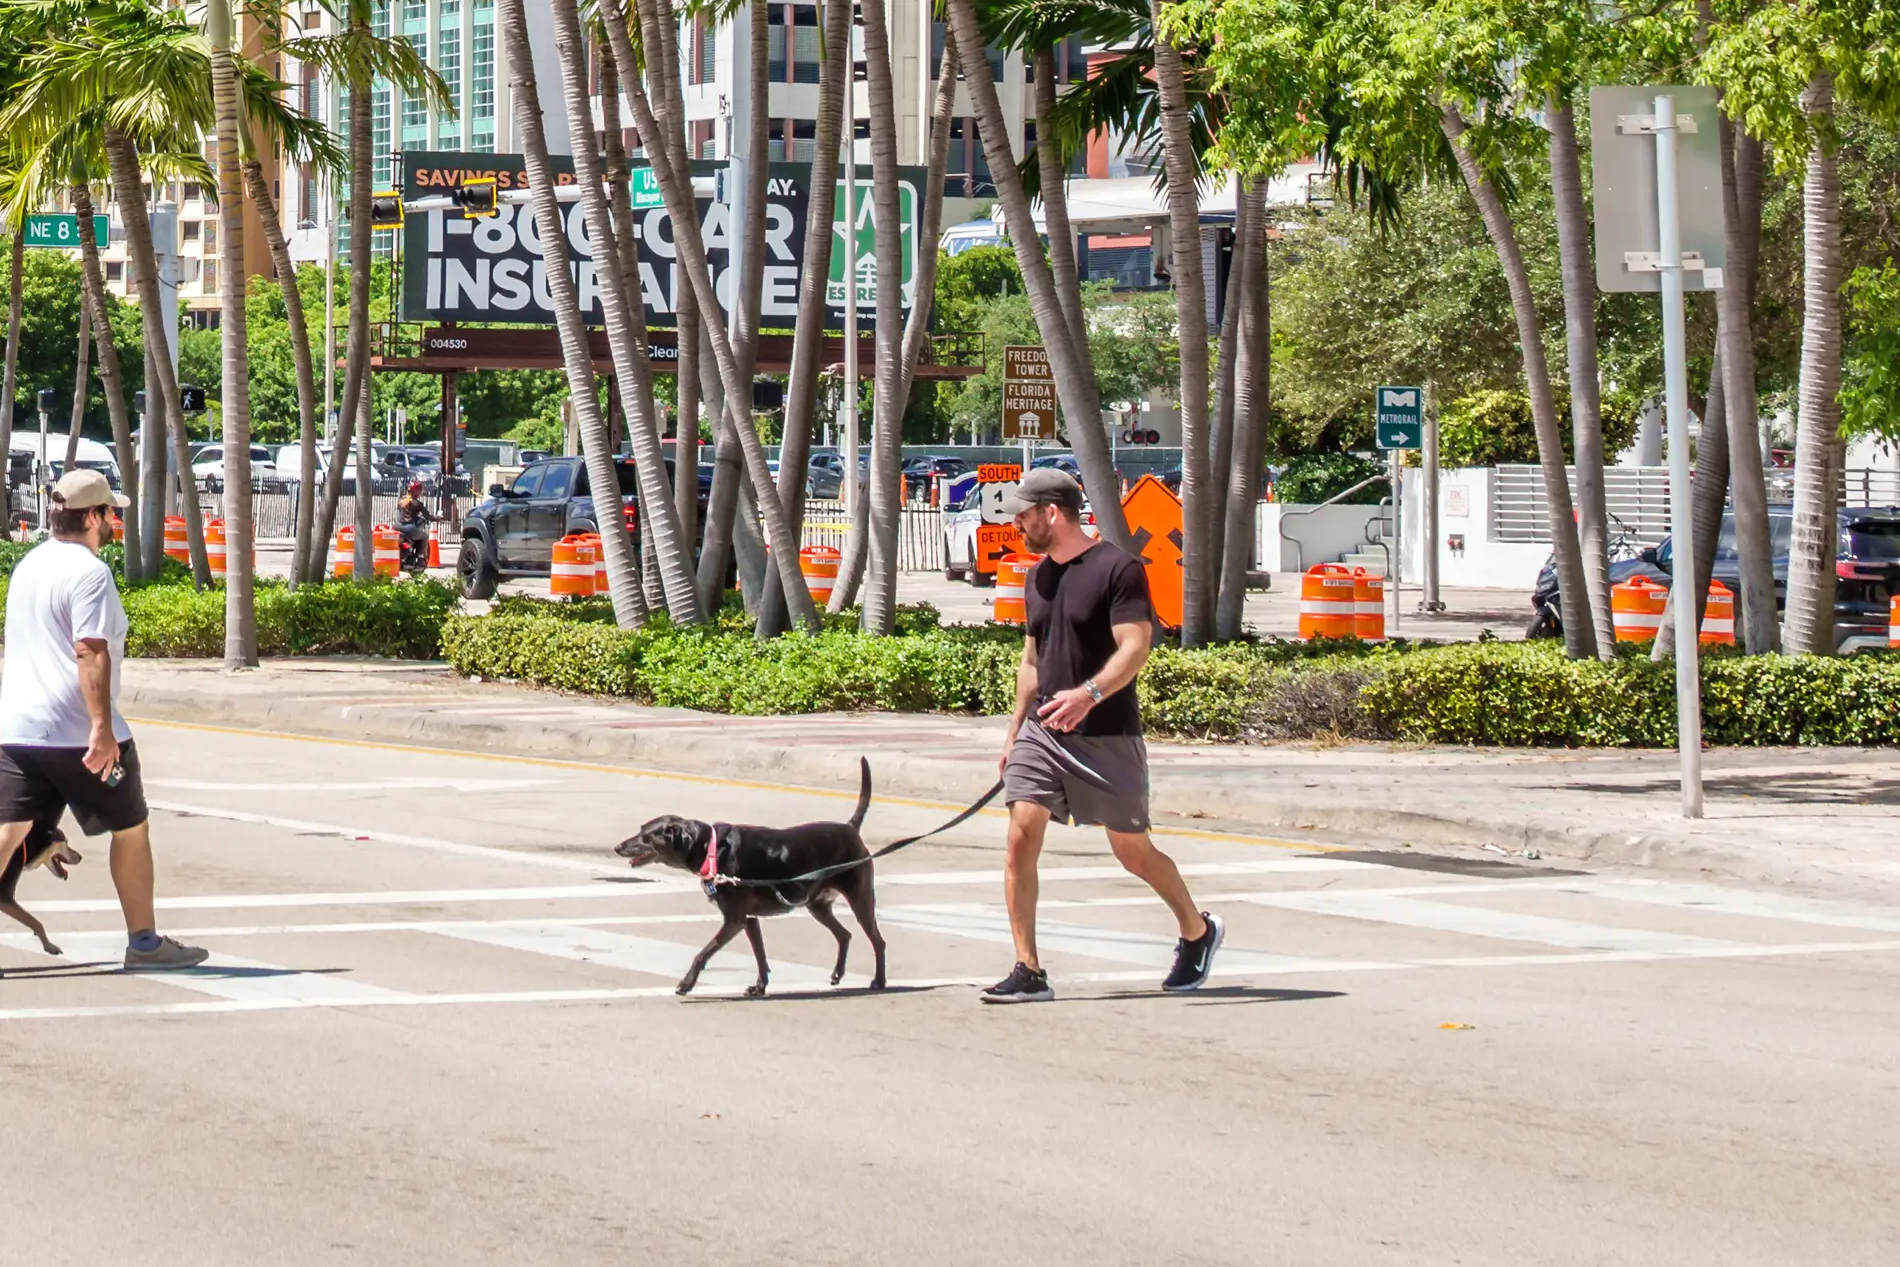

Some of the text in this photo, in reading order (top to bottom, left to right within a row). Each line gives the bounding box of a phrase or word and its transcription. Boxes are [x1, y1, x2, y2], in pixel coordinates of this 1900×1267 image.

[30, 221, 51, 238] NE
[57, 221, 70, 240] 8
[430, 338, 467, 349] 004530
[647, 345, 679, 358] Clear
[1008, 350, 1047, 362] FREEDO
[1015, 364, 1048, 375] TOWER
[1008, 385, 1051, 396] FLORIDA
[1006, 398, 1053, 411] HERITAGE
[1380, 414, 1418, 425] METRORAIL
[980, 467, 1020, 480] SOUTH
[994, 489, 1004, 514] 1
[981, 530, 1024, 543] DETOUR
